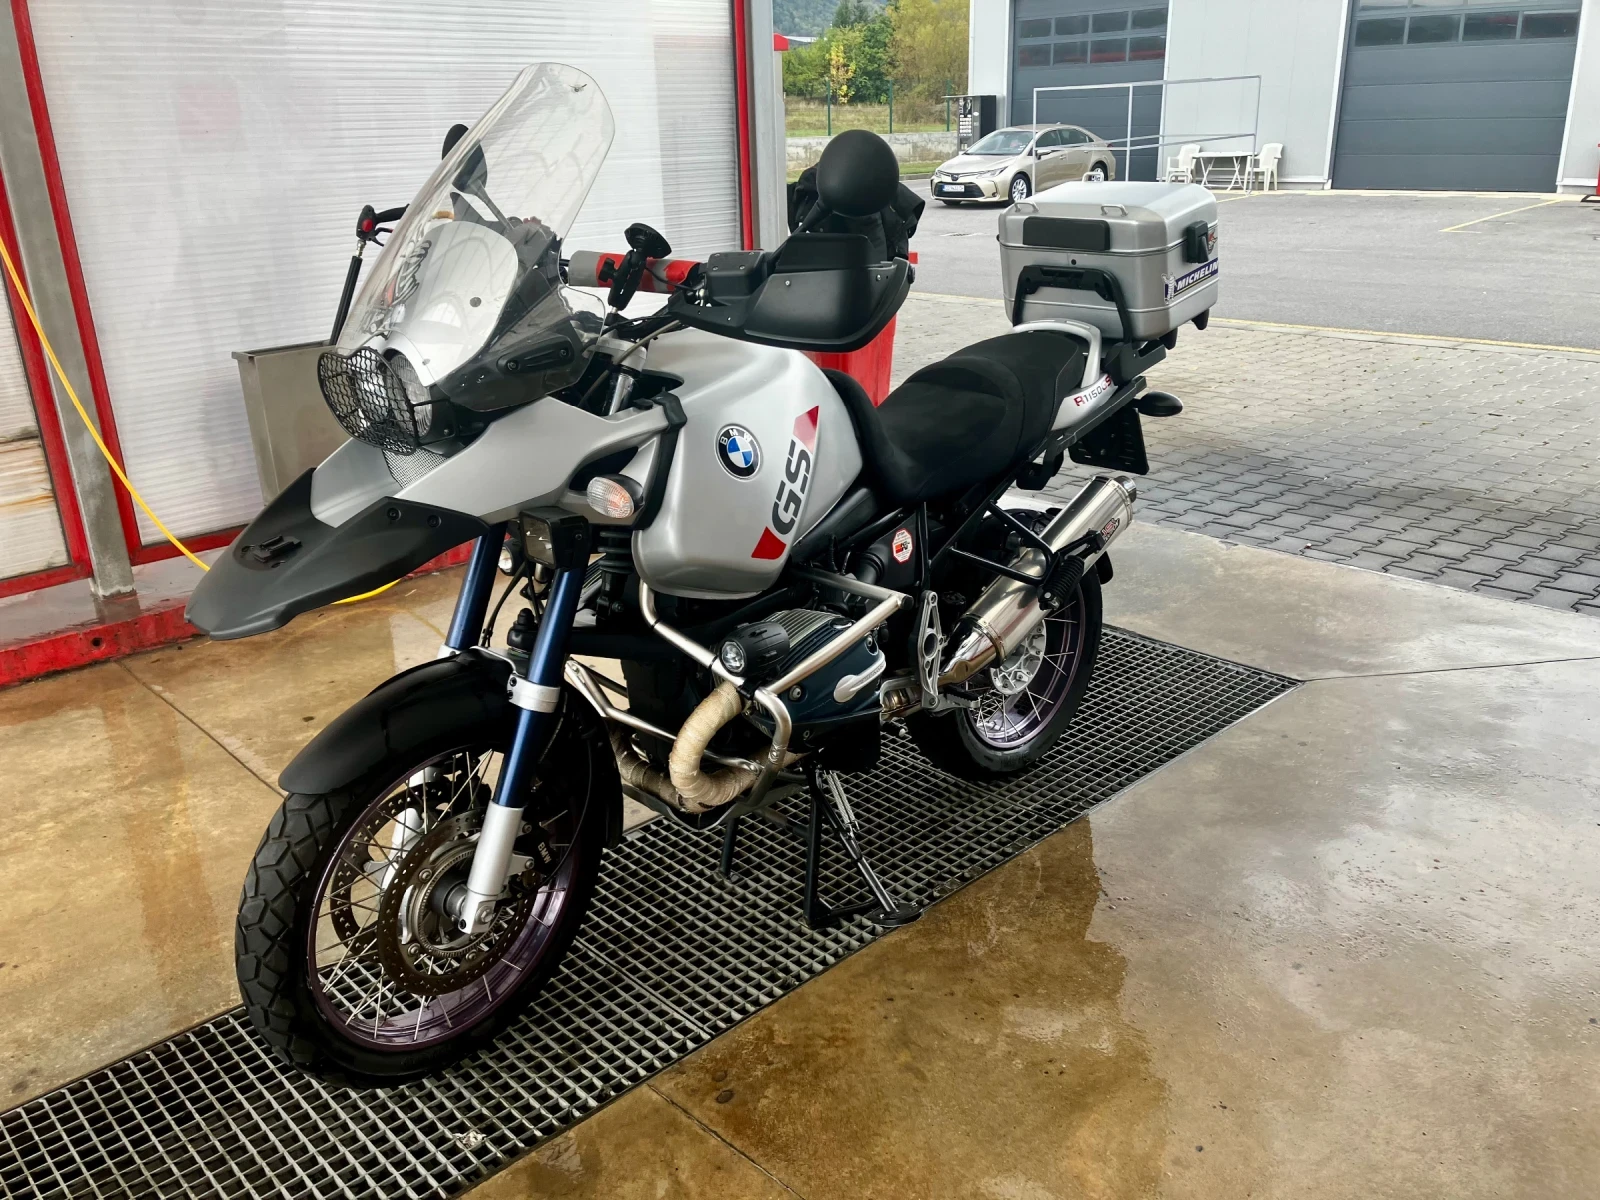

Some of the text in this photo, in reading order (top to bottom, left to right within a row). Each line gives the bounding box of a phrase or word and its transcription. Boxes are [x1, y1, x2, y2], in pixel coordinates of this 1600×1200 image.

[1177, 260, 1218, 291] MICHELIN
[719, 428, 752, 446] BMW
[771, 438, 811, 536] GS
[537, 841, 552, 864] BMW
